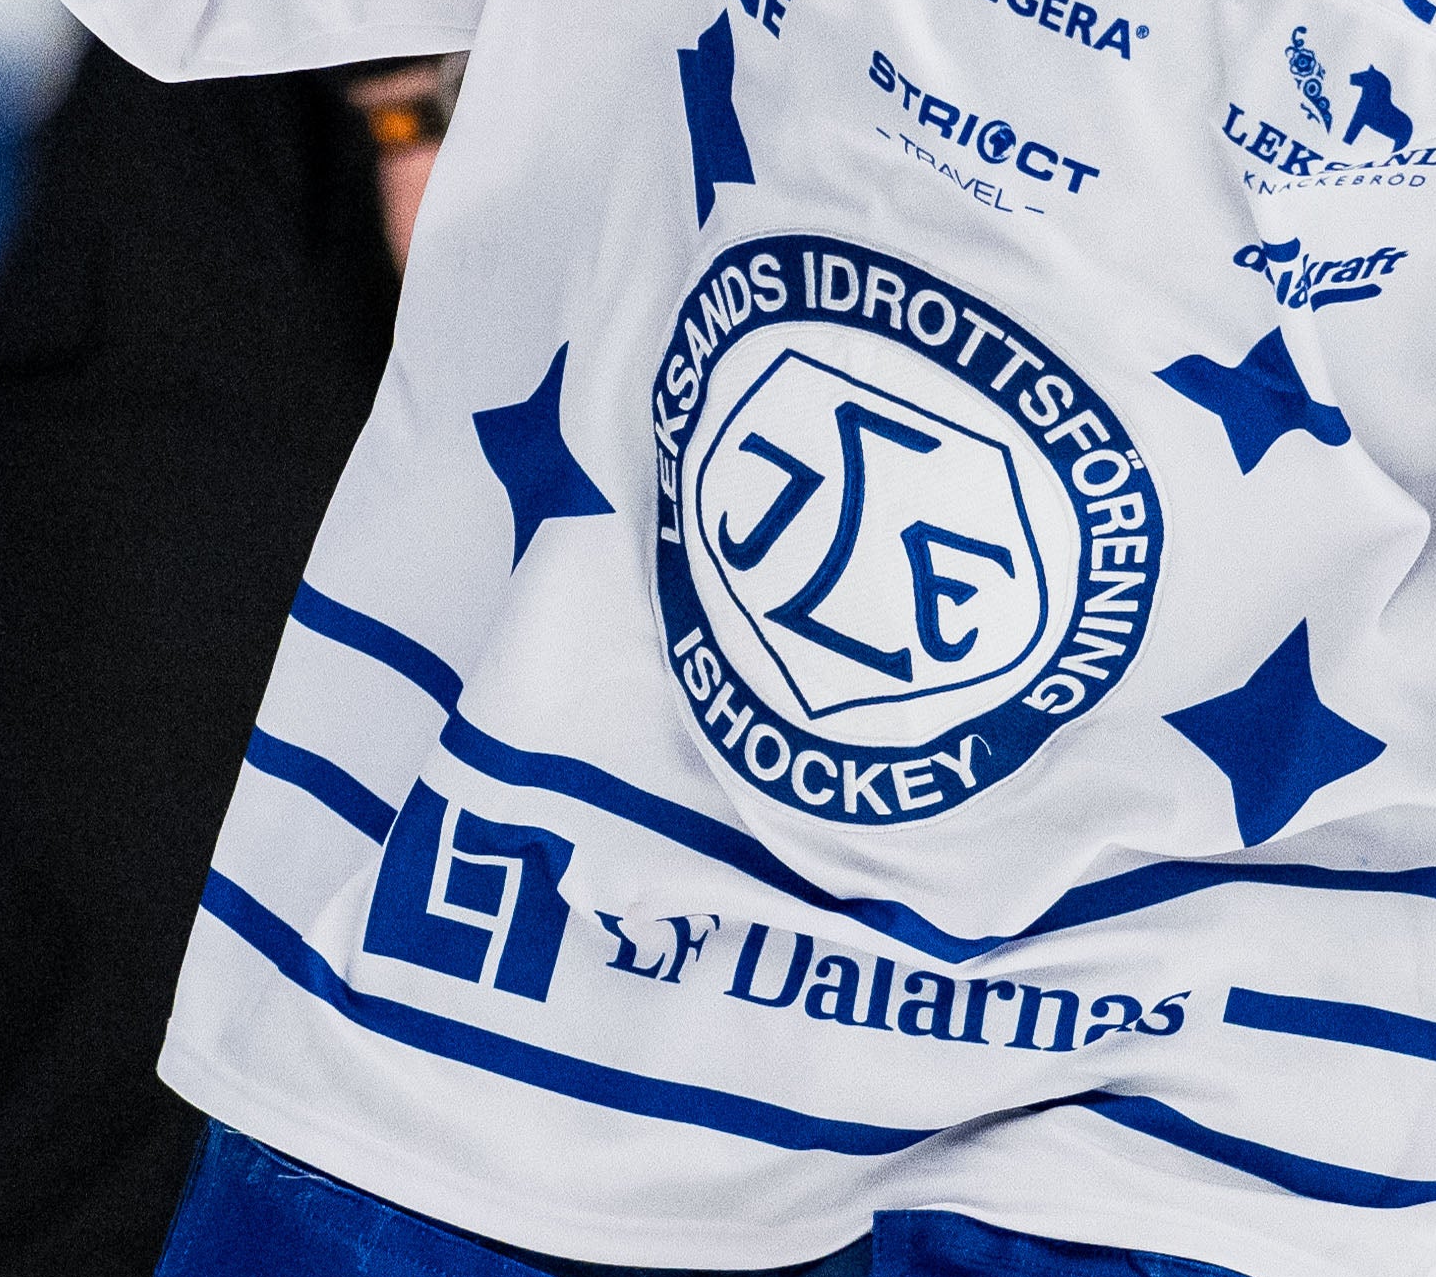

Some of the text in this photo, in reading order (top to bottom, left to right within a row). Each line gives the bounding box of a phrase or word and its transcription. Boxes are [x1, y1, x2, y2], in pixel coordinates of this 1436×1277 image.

[898, 132, 1013, 212] TRAVEL
[654, 251, 1147, 715] LEKSANDS IDROTTSFÖRENING
[674, 629, 992, 817] ISHOCKEY
[725, 923, 1193, 1053] Dalarnas
